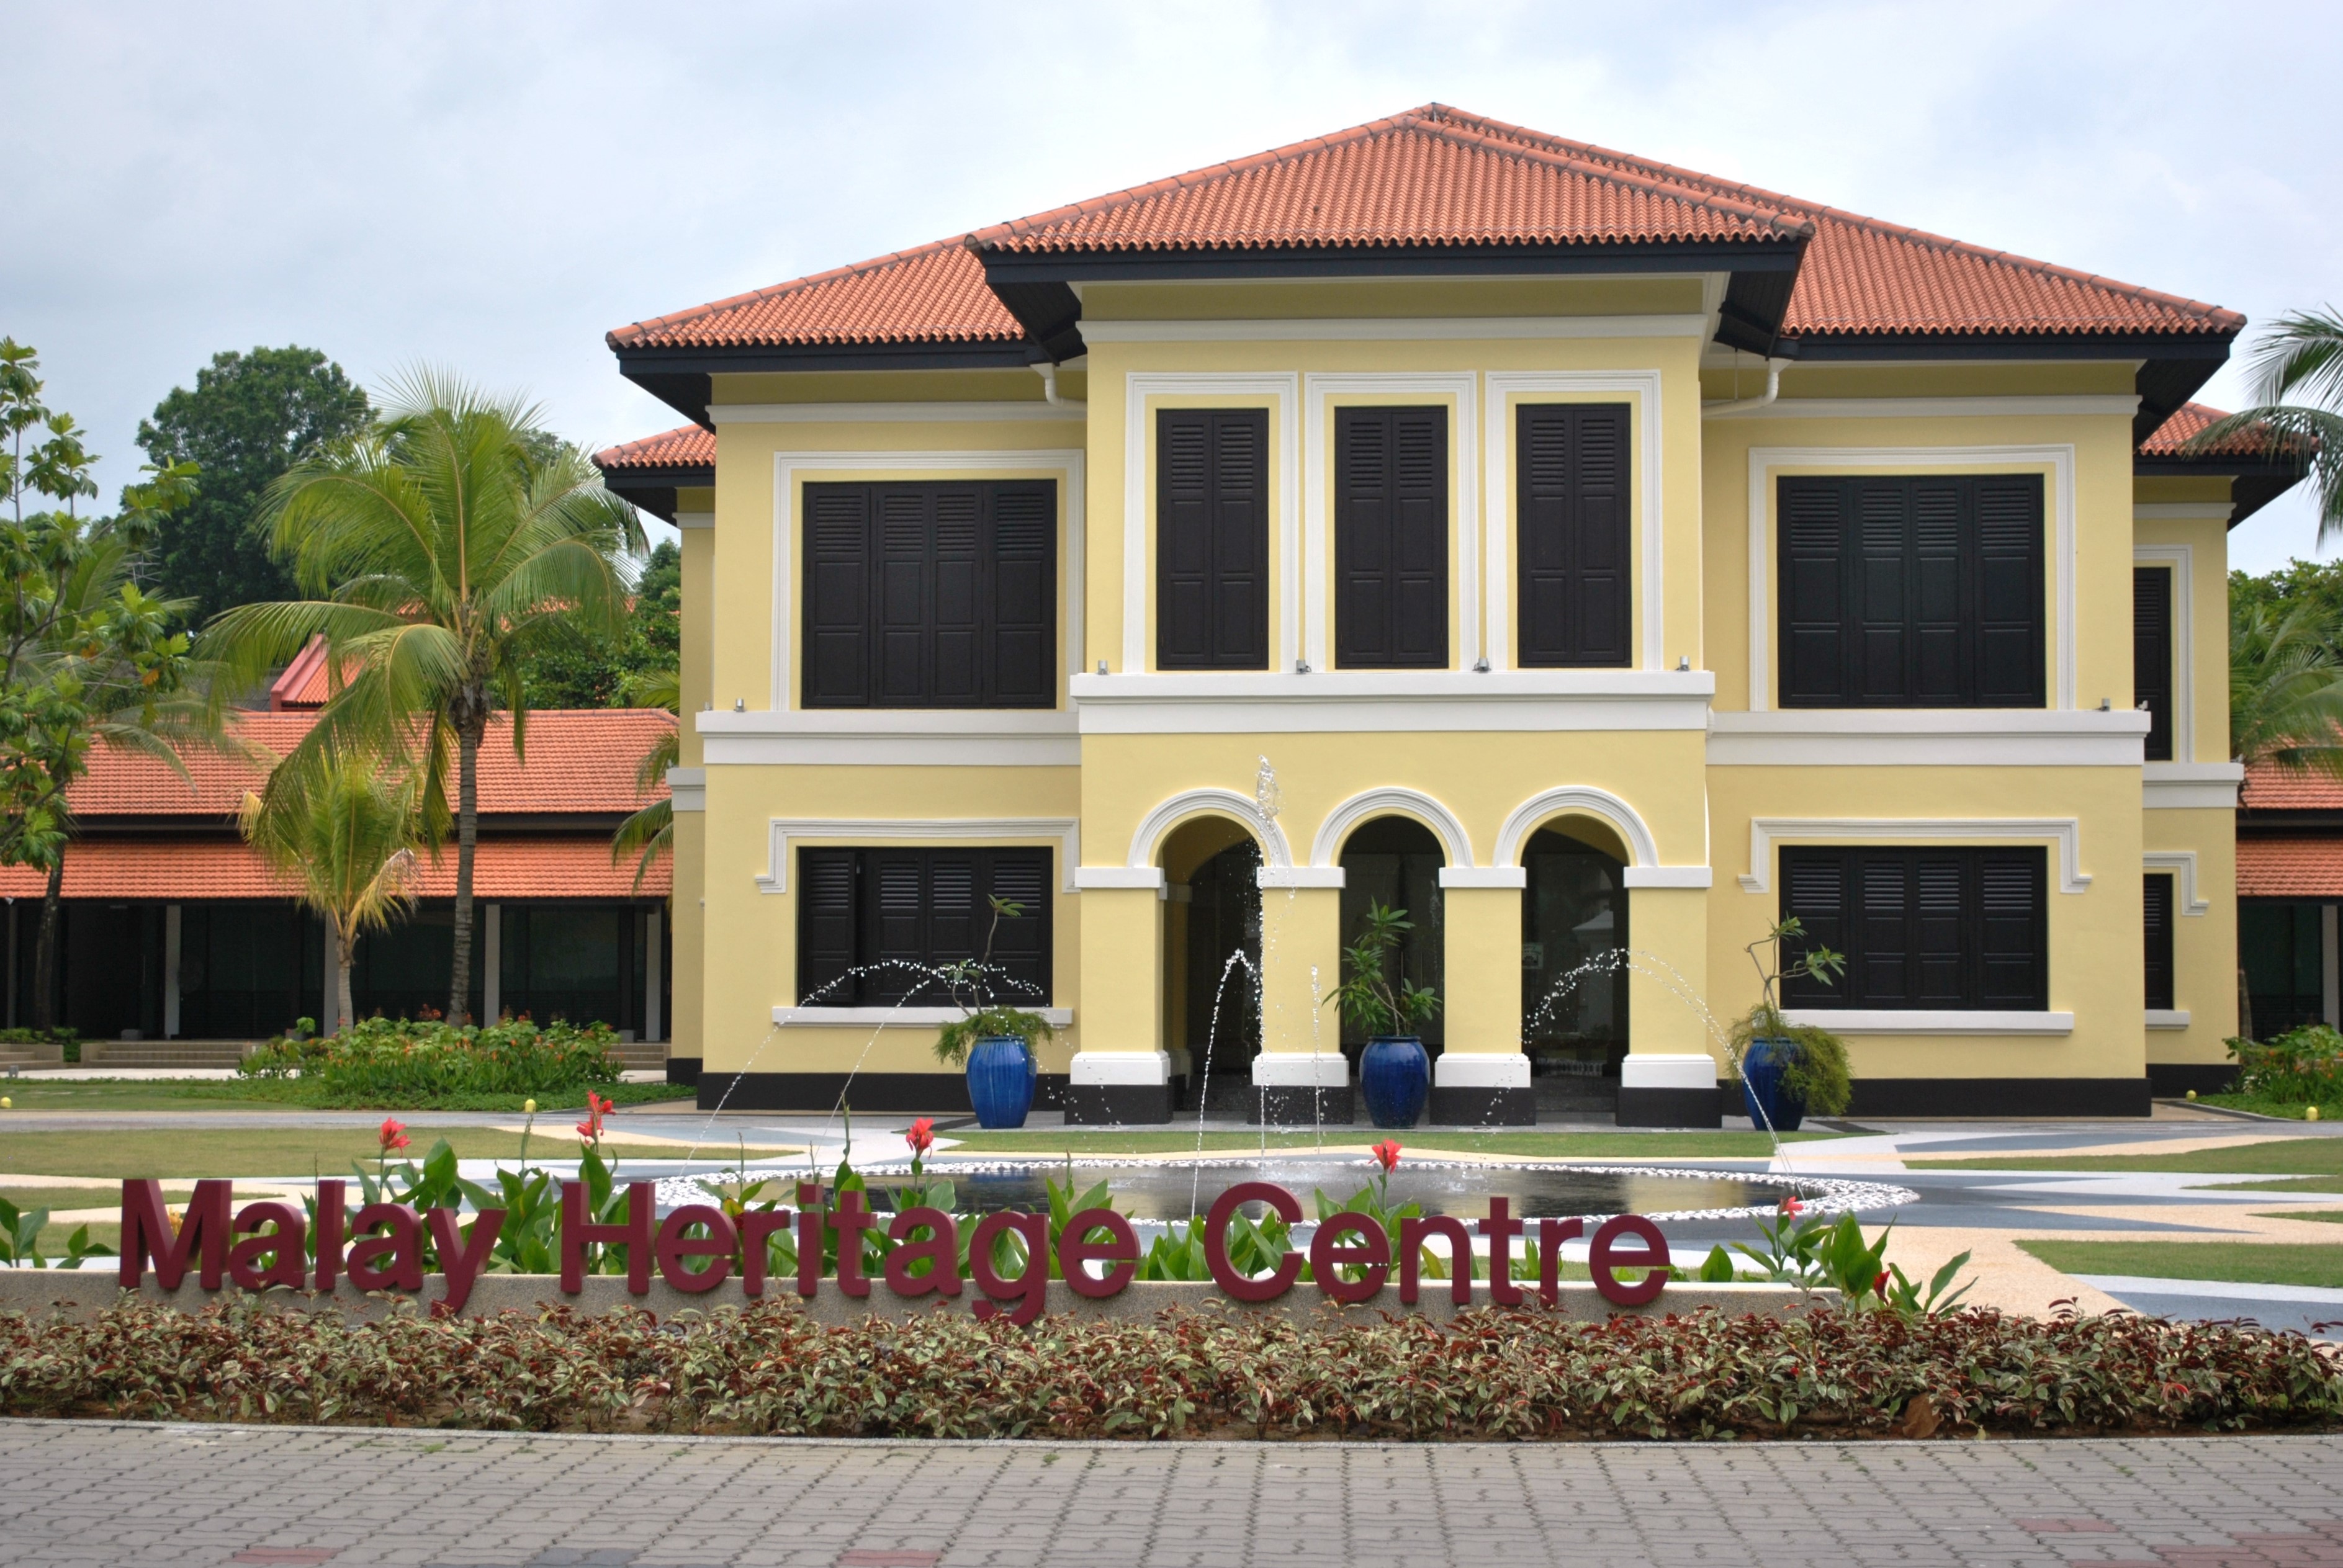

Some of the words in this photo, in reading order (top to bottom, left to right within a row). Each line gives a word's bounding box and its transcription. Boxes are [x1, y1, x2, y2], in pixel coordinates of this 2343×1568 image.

[120, 1179, 508, 1317] Malay
[560, 1181, 1141, 1327] Heritage
[1204, 1181, 1671, 1306] Centre
